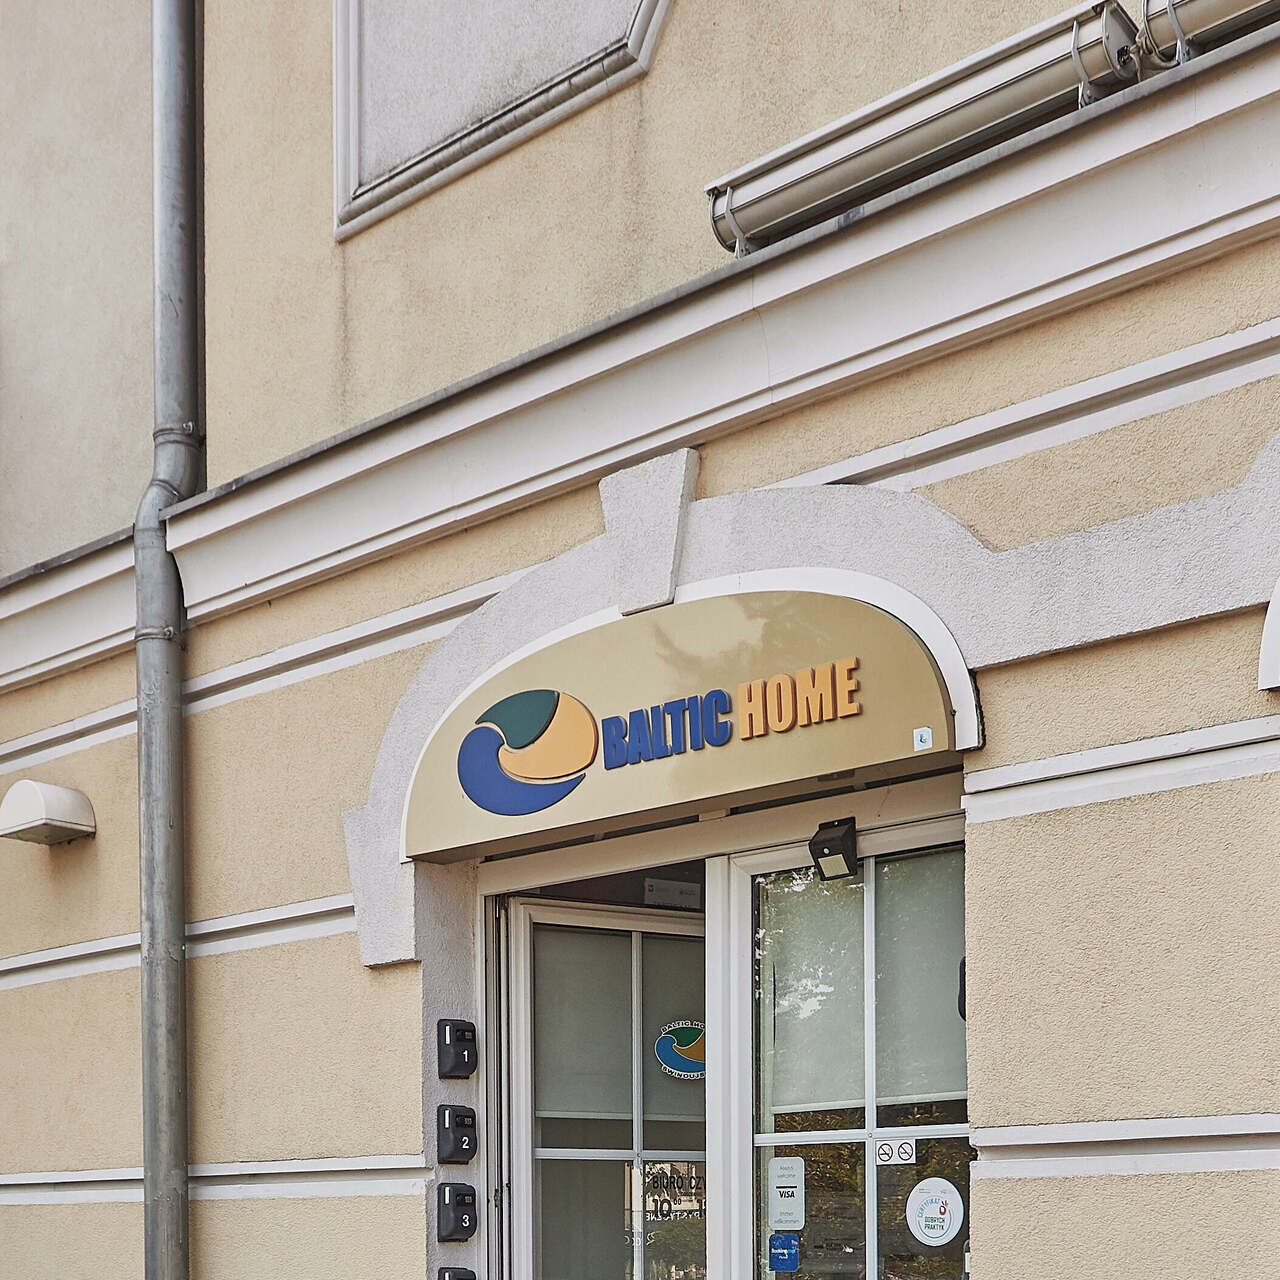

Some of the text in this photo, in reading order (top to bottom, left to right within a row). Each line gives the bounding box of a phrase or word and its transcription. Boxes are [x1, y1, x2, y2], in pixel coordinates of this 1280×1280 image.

[601, 655, 863, 771] BALTIC HOME
[462, 1050, 469, 1063] 1
[461, 1136, 470, 1149] 2
[652, 1175, 683, 1190] BIURO
[778, 1190, 796, 1199] VISA
[461, 1214, 470, 1227] 3
